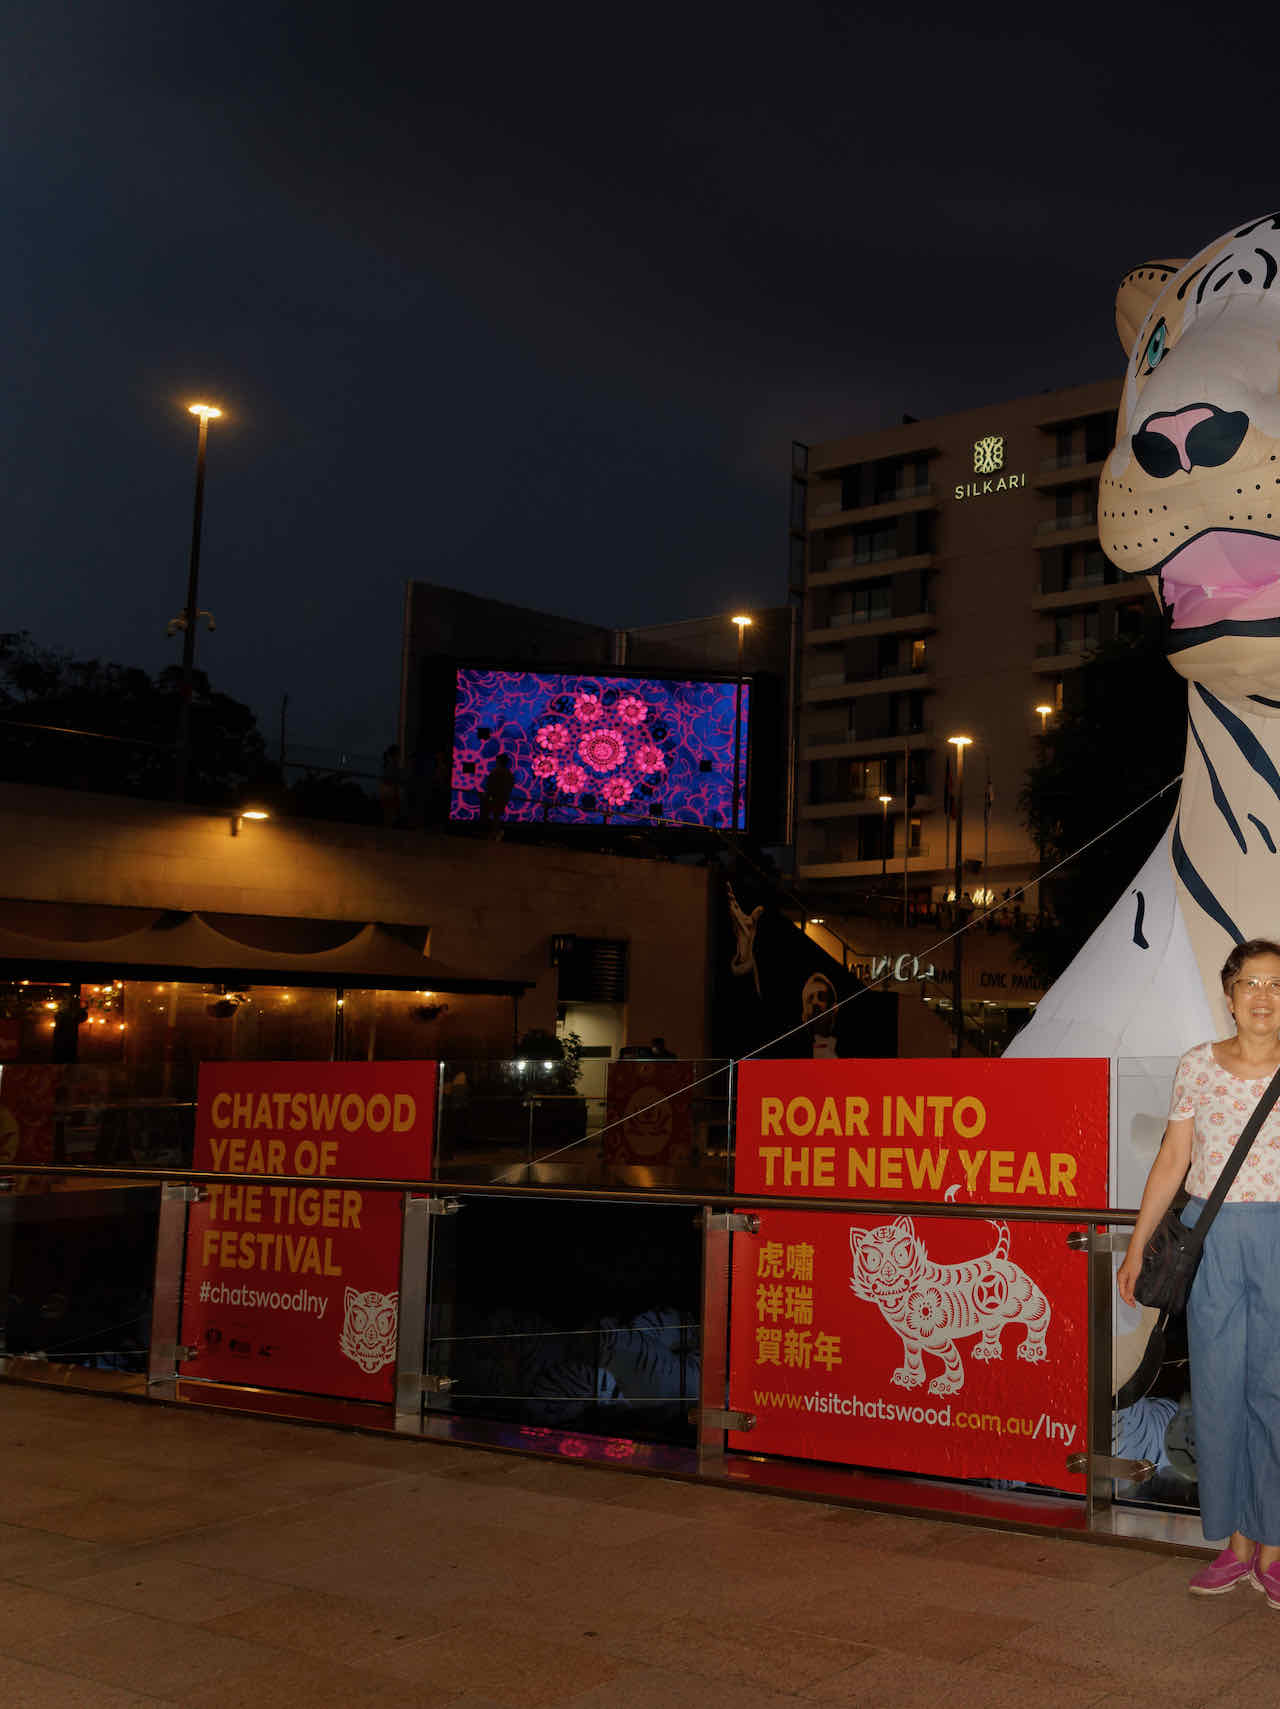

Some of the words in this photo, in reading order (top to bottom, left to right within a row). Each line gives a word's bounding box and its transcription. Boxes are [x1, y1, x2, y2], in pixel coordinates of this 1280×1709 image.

[954, 473, 1025, 500] SILKARI
[210, 1091, 416, 1133] CHATSWOOD
[760, 1096, 870, 1137] ROAR
[882, 1095, 987, 1139] INTO
[209, 1138, 287, 1175] YEAR
[294, 1139, 340, 1176] OF
[758, 1146, 836, 1187] THE
[848, 1147, 950, 1191] NEW
[957, 1149, 1078, 1197] YEAR
[207, 1184, 263, 1224] THE
[270, 1186, 363, 1230] TIGER
[201, 1230, 343, 1277] FESTIVAL
[756, 1240, 815, 1281] 虎嘯
[200, 1281, 328, 1320] #chatswoodlny
[756, 1282, 815, 1325] 祥瑞
[755, 1326, 844, 1372] 賀新年
[753, 1390, 1077, 1447] www.visitchatswood.com.au/lny
